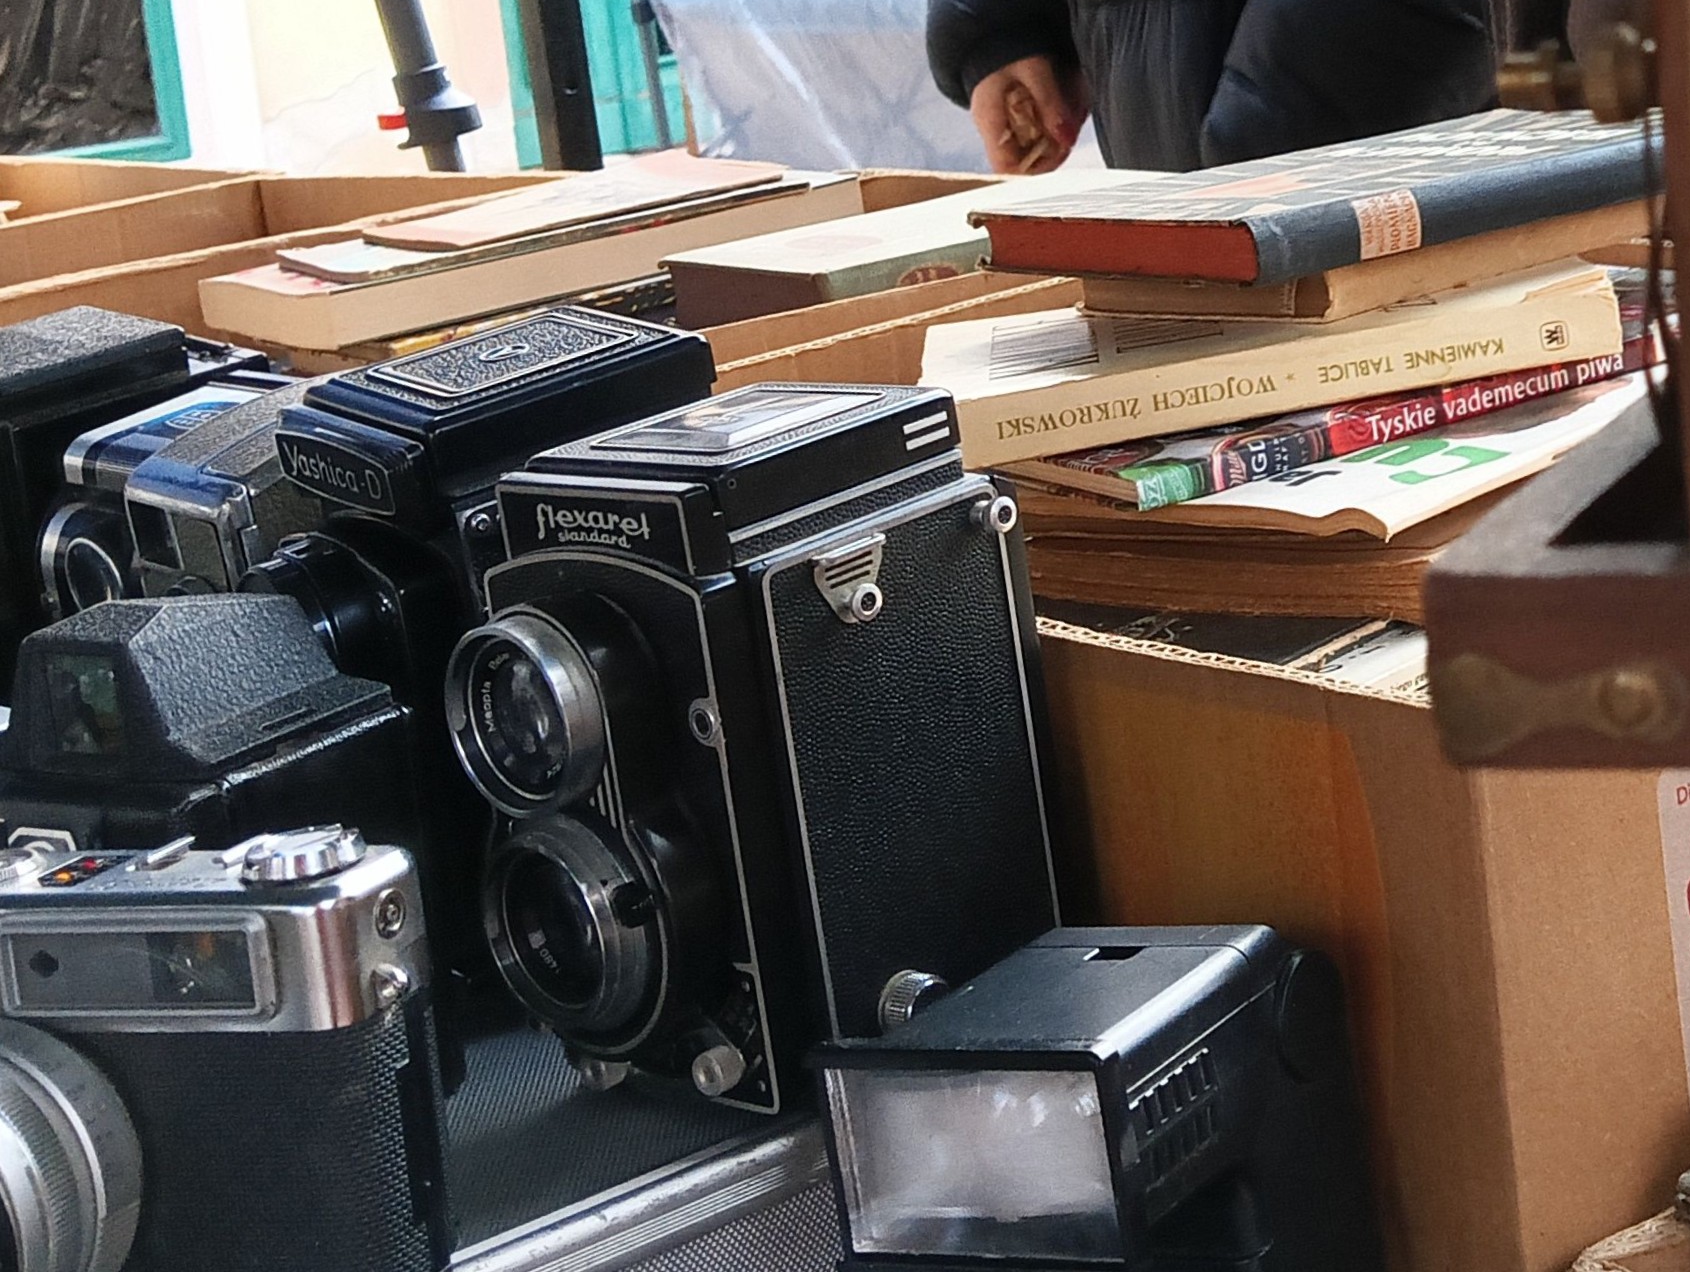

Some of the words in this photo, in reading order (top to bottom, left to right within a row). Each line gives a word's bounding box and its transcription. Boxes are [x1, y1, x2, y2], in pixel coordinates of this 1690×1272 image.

[1318, 356, 1394, 383] TABLICE
[1404, 338, 1505, 369] KAMIENNE
[1151, 375, 1277, 412] WOJCIECH
[1365, 407, 1436, 444] Tyskie
[1443, 369, 1570, 420] vademecum
[1576, 353, 1624, 383] piwa
[997, 397, 1142, 439] ŻUKROWSKI
[281, 442, 382, 501] Yashica-D
[536, 503, 651, 541] flexaret
[558, 531, 631, 549] standard
